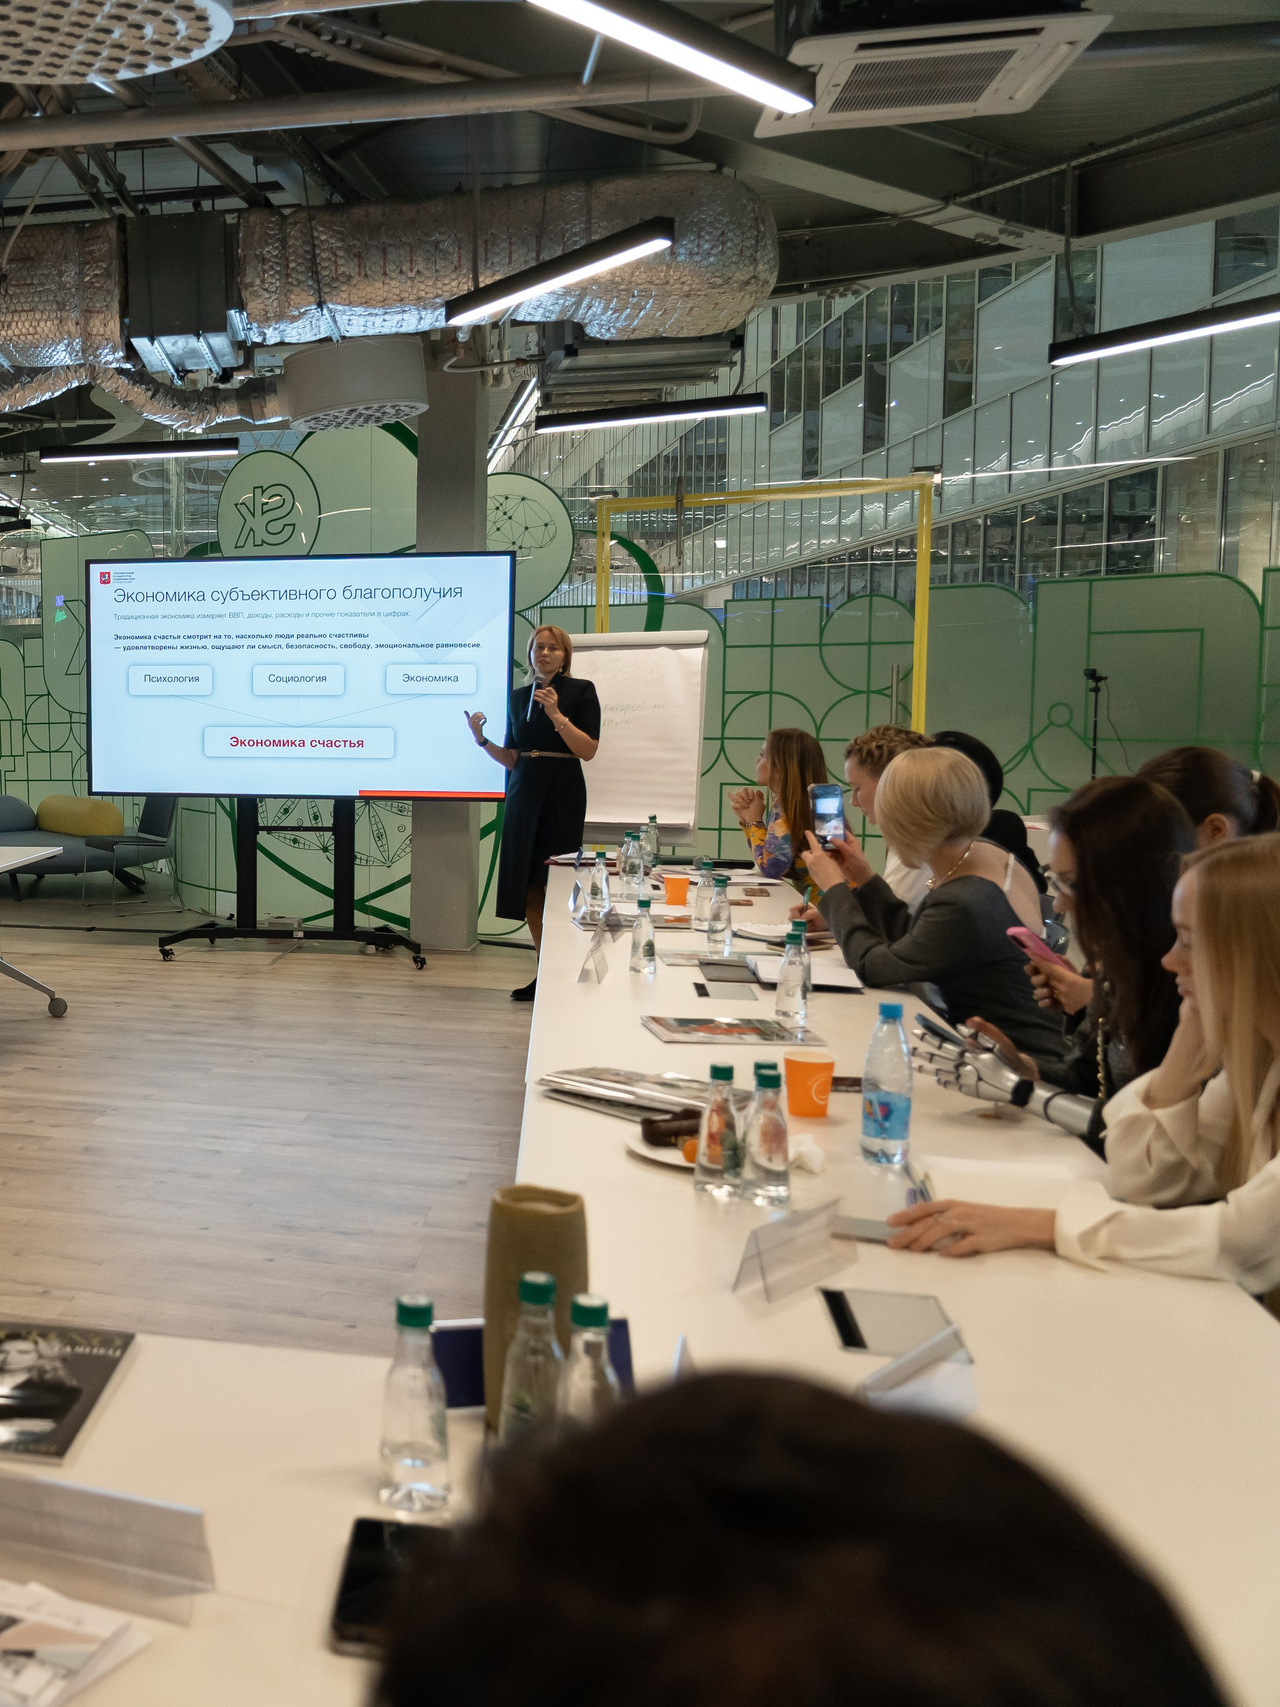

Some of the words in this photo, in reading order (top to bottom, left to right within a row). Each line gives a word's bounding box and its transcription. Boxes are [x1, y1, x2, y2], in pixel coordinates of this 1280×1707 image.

[113, 587, 207, 604] Экономика
[210, 585, 337, 606] субъективного
[342, 584, 463, 603] благополучия
[113, 612, 160, 621] Традиционная
[196, 612, 227, 621] измеряет
[228, 611, 246, 620] ВВП,
[246, 612, 274, 620] доходы,
[275, 611, 303, 619] расходы
[311, 611, 335, 619] прочие
[113, 633, 152, 641] Экономика
[122, 644, 179, 652] удовлетворены
[210, 643, 245, 652] ощущают
[285, 642, 338, 650] безопасность,
[339, 642, 373, 650] свободу,
[374, 642, 434, 650] эмоциональное
[435, 641, 483, 650] равновесие.
[143, 673, 200, 684] Психология
[267, 673, 328, 684] Социология
[401, 672, 460, 682] Экономика
[229, 735, 306, 748] Экономика
[309, 738, 365, 749] счастья
